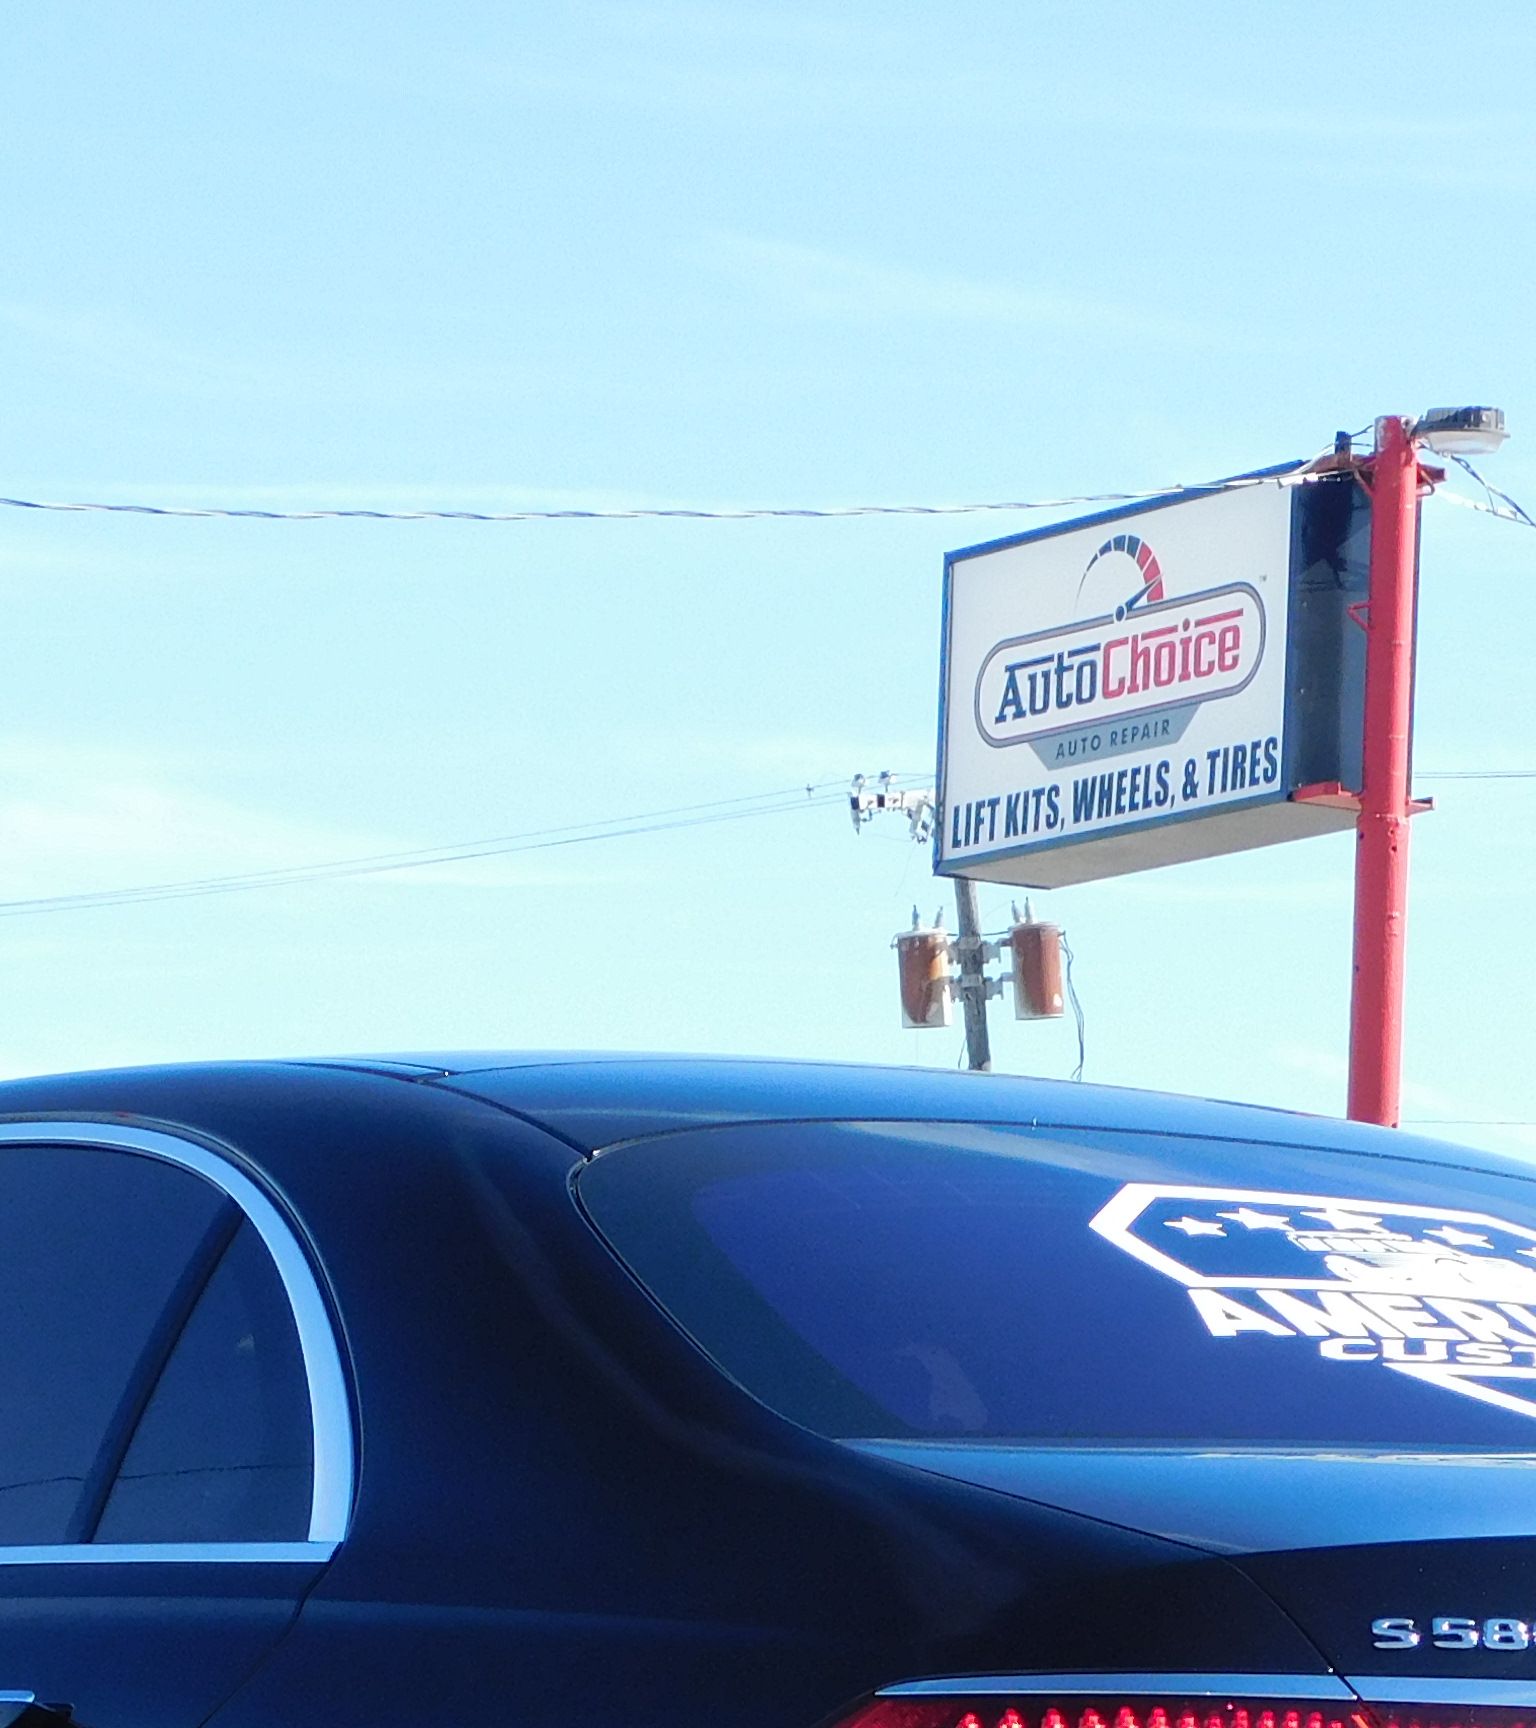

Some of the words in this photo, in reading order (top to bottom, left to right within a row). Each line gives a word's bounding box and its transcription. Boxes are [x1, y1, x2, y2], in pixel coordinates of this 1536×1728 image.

[994, 608, 1244, 724] AutoChoice
[1056, 734, 1102, 760] AUTO
[1110, 719, 1170, 747] REPAIR
[951, 796, 1001, 848] LIFT
[1004, 783, 1065, 838] KITS,
[1073, 759, 1175, 825] WHEELS,
[1182, 758, 1200, 801] &
[1206, 736, 1278, 796] TIRES
[1371, 1617, 1420, 1650] S
